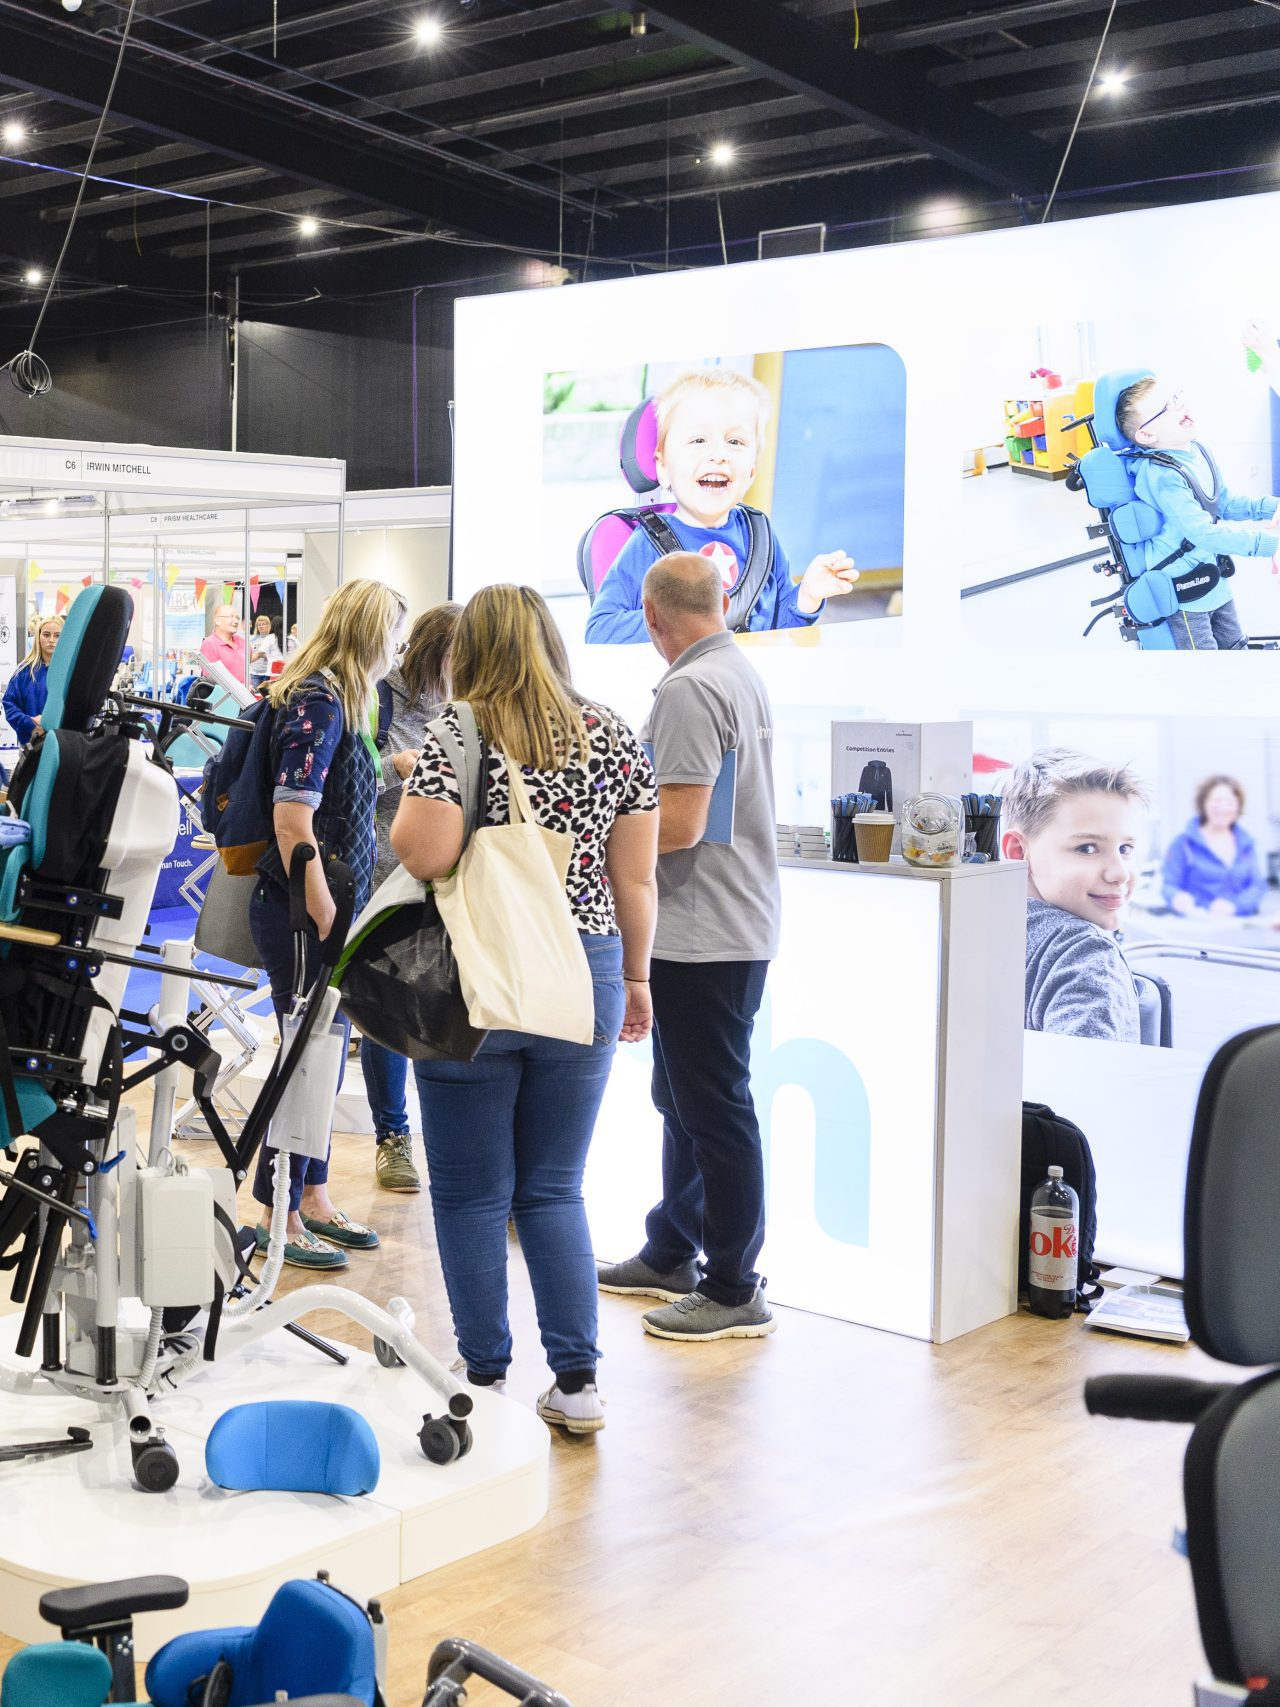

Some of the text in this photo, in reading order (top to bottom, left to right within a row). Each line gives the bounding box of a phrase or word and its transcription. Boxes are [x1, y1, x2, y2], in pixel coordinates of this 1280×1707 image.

[65, 460, 76, 470] C6
[86, 461, 152, 475] IRWIN MITCHELL
[163, 513, 219, 522] PRISM HEALTHCARE
[173, 858, 193, 867] Touch.
